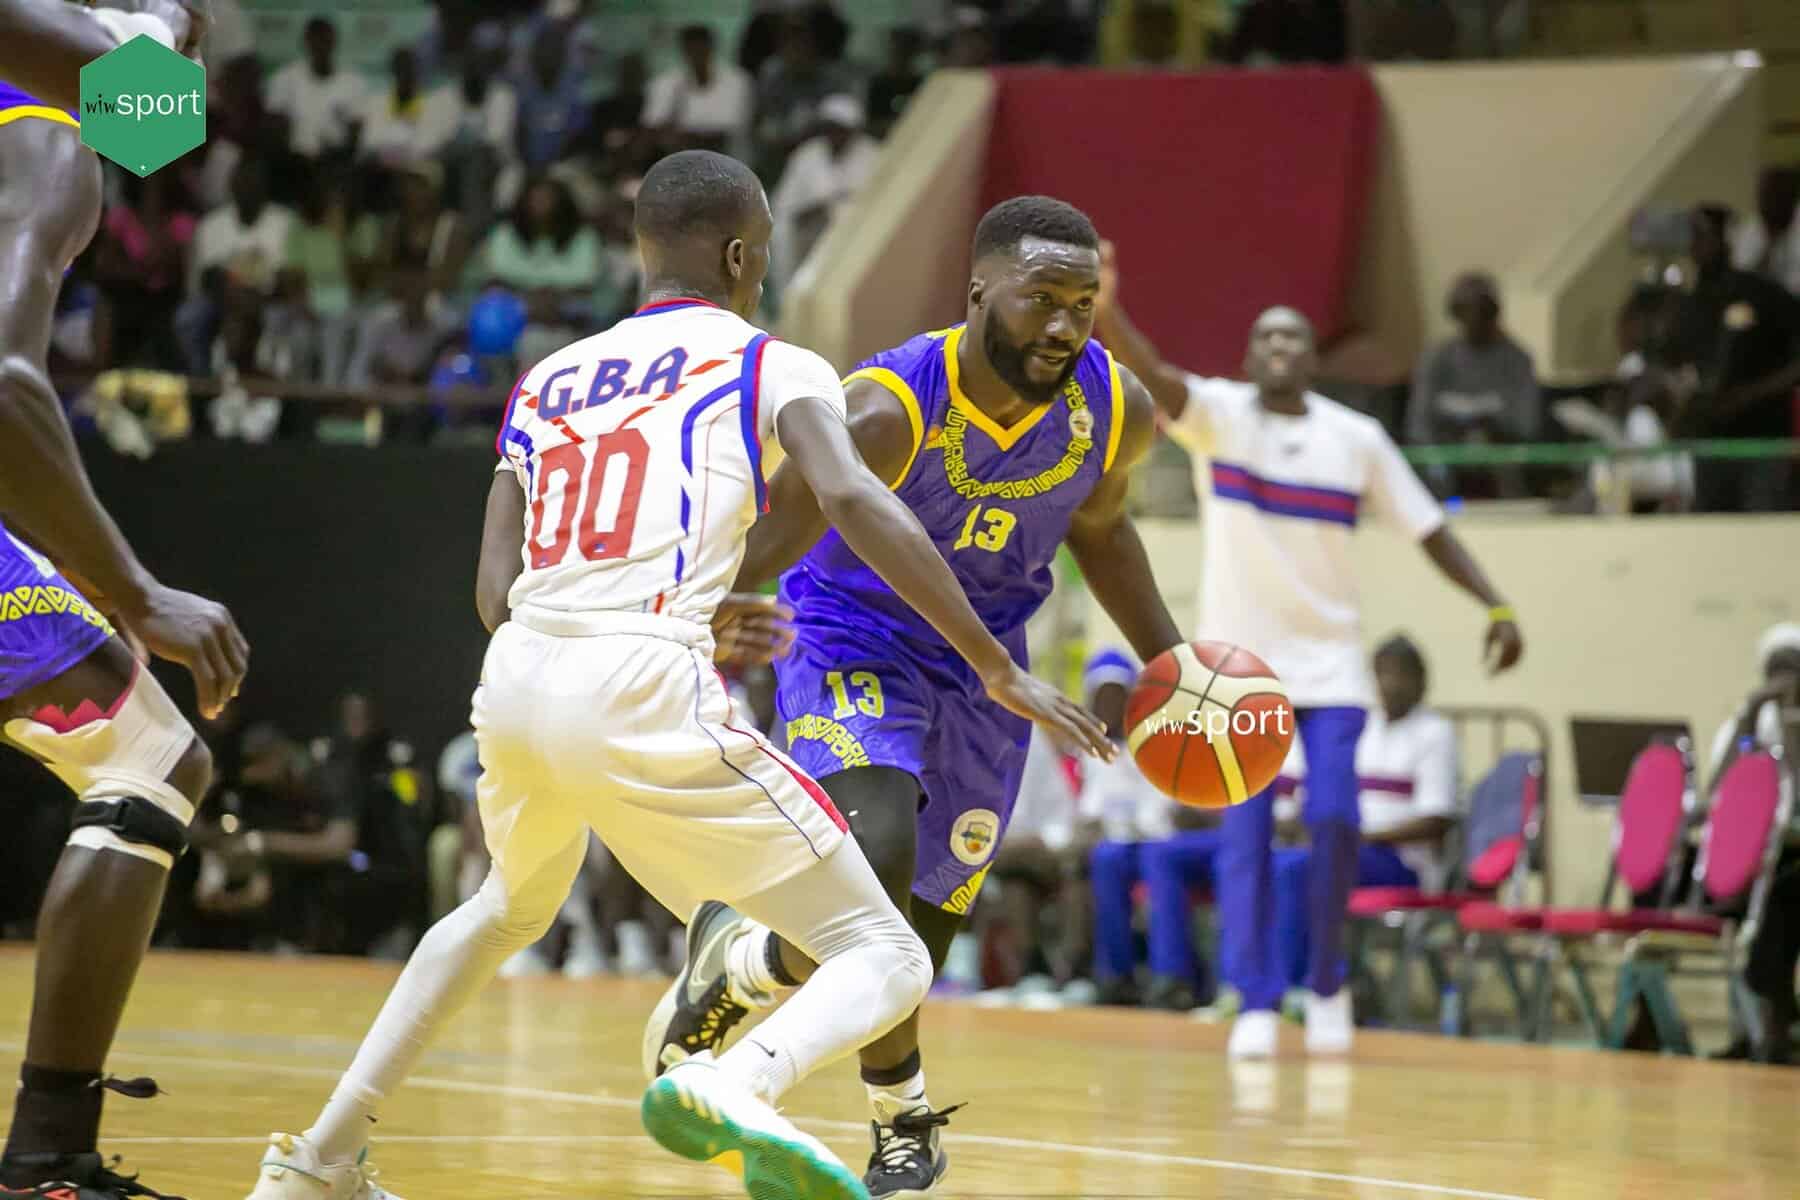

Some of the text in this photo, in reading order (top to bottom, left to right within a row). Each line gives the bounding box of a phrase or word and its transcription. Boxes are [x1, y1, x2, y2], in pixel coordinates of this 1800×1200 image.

[537, 346, 688, 422] G.B.A
[528, 427, 650, 570] 00
[953, 503, 1017, 553] 13
[826, 671, 885, 720] 13
